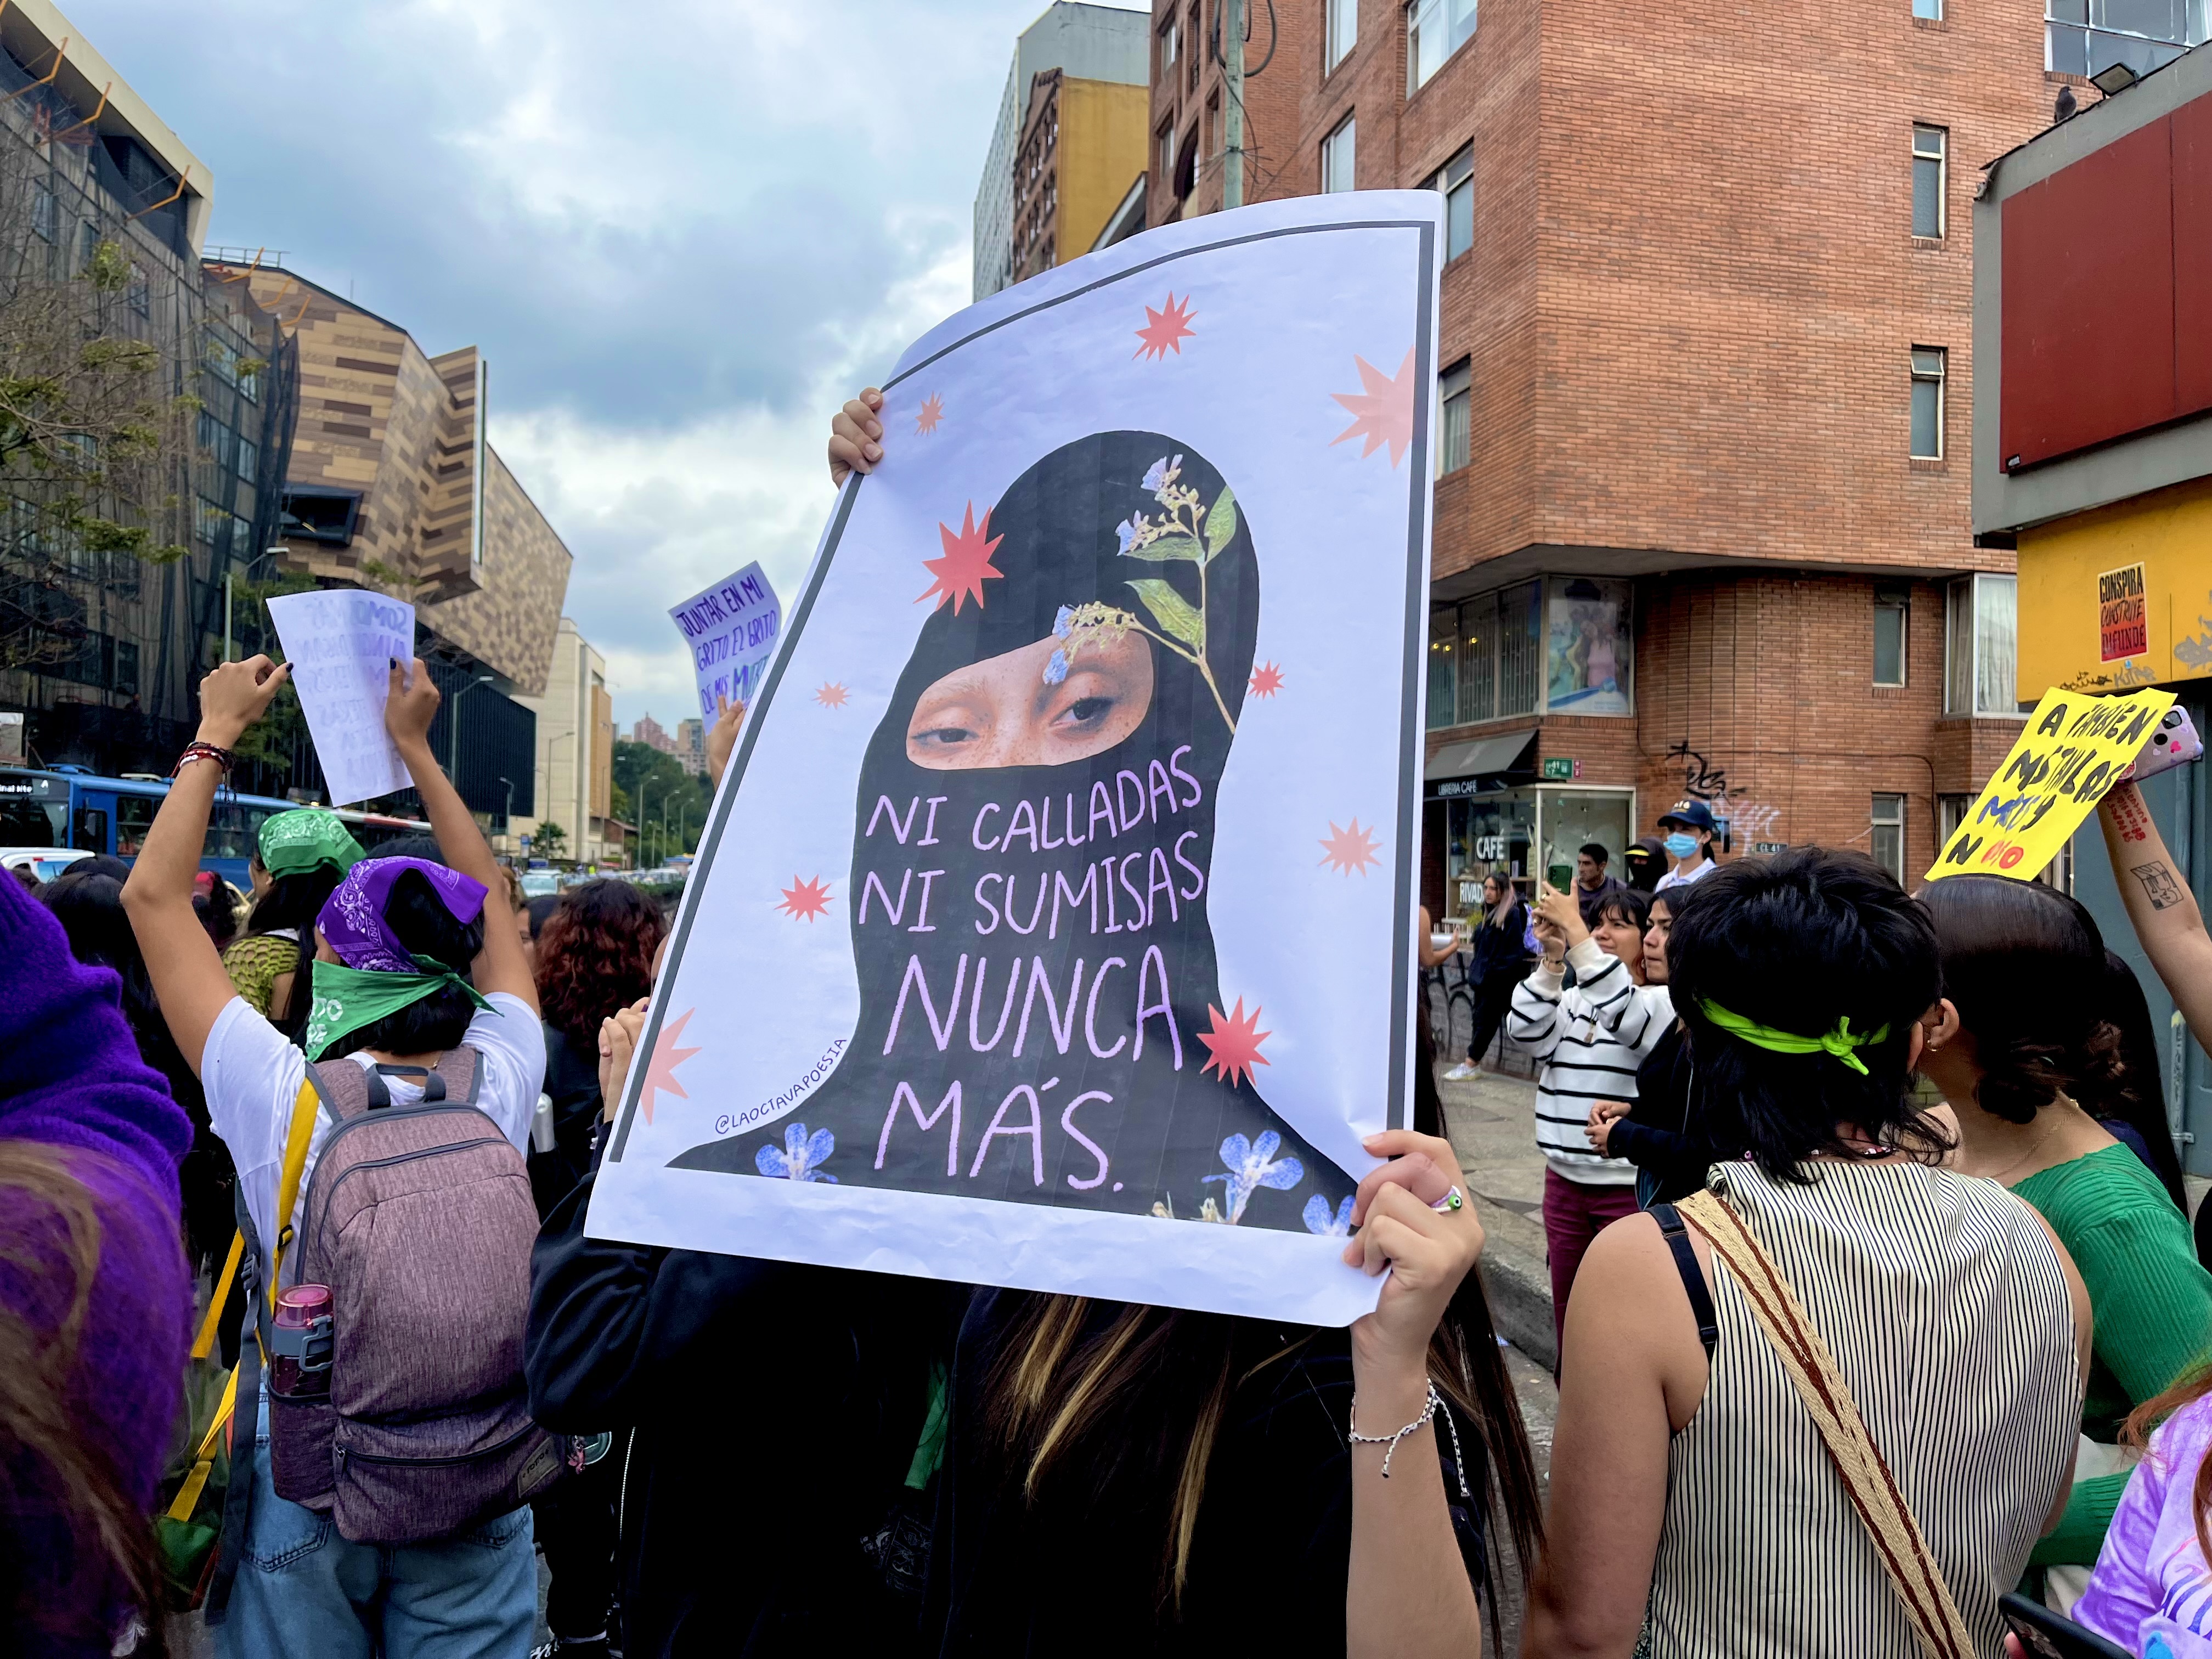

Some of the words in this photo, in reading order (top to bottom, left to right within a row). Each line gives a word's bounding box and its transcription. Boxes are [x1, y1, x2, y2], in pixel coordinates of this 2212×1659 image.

[676, 595, 729, 637] JUNTAR
[721, 583, 746, 613] EN
[740, 573, 765, 605] MI
[2100, 567, 2143, 603] CONSPIRA
[2101, 598, 2145, 628] CONSTRUYE
[696, 635, 729, 671] GRITO
[747, 610, 777, 647] GRITO
[2102, 625, 2146, 654] DIFUNDE
[701, 684, 715, 714] DE
[865, 794, 948, 846] NI
[972, 744, 1201, 853] CALLADAS
[1476, 828, 1504, 860] CAFÉ
[859, 868, 945, 932] NI
[975, 831, 1204, 939] SUMISAS
[883, 945, 1183, 1071] NUNCA
[715, 1039, 848, 1135] @LAOCTAVAPOESIA
[874, 1077, 1124, 1192] MÁS.
